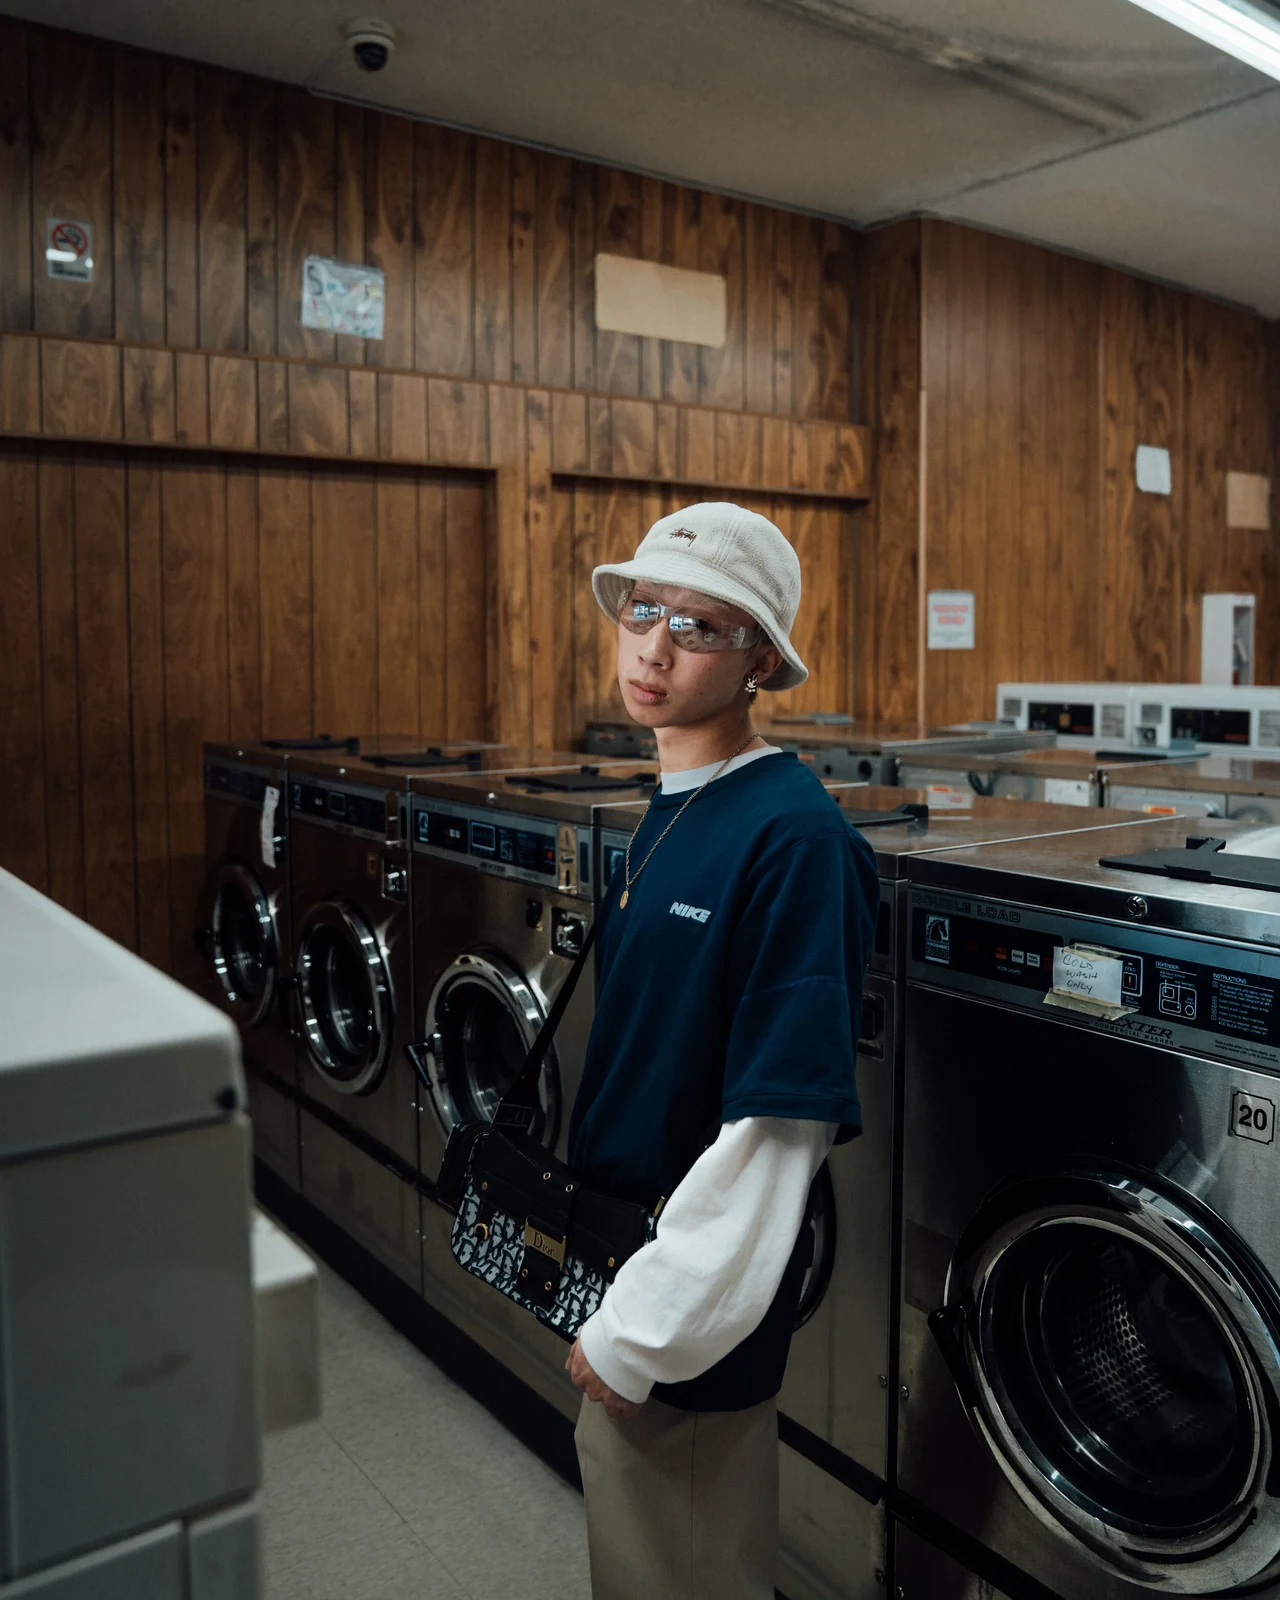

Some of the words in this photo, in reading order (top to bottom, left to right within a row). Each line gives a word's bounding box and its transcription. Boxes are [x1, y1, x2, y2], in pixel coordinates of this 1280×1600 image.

[669, 902, 712, 924] NIKE
[912, 892, 971, 914] DOUBLE
[977, 904, 1020, 923] LOAD
[1062, 953, 1094, 970] COLD
[1066, 970, 1098, 980] WASH
[1213, 972, 1247, 984] INSTRUCTIONS
[1066, 980, 1093, 994] ONLY
[1094, 1022, 1140, 1037] COMMERCIAL
[1144, 1034, 1174, 1046] WASHER
[1238, 1105, 1267, 1130] 20
[533, 1232, 554, 1255] Dior
